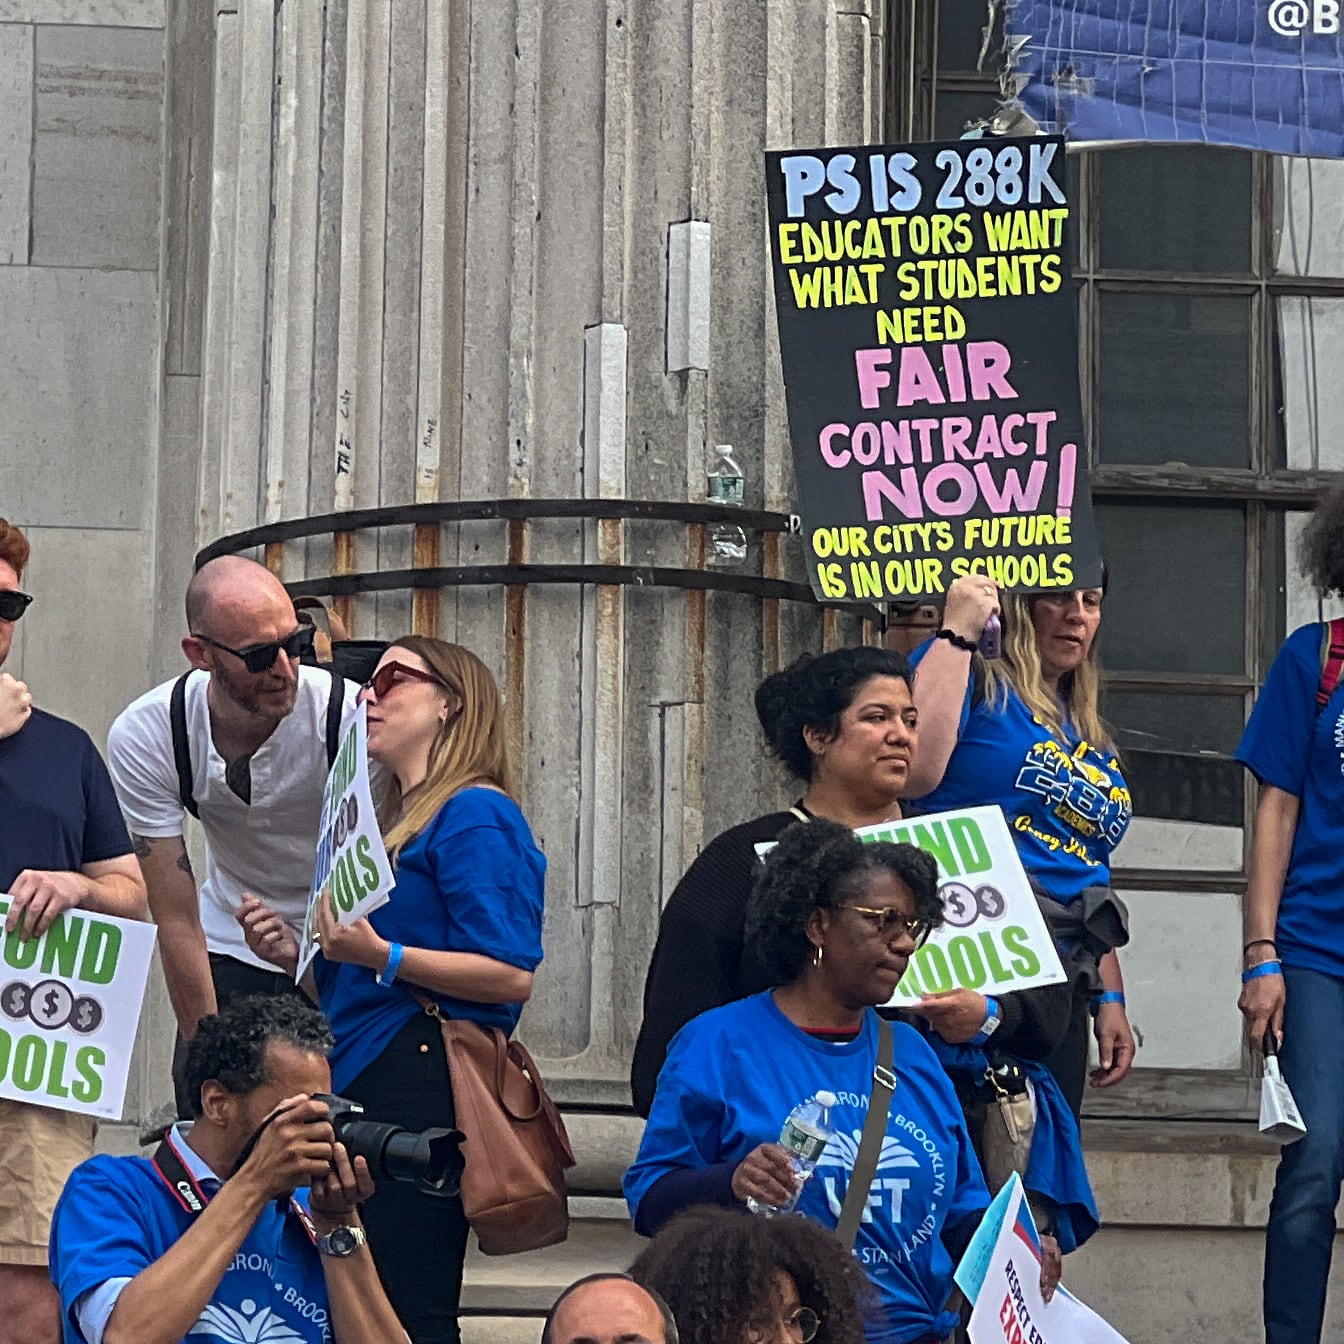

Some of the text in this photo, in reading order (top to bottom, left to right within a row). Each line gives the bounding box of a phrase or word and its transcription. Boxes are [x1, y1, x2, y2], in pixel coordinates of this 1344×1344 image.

[780, 143, 1067, 218] PS IS 288K
[778, 208, 1068, 264] EDUCATORS WANT
[789, 254, 1061, 309] WHAT STUDENTS
[876, 305, 966, 344] NEED
[855, 341, 1019, 409] FAIR
[819, 411, 1057, 468] CONTRACT
[862, 443, 1077, 521] NOW!
[812, 527, 871, 558] OUR
[964, 515, 1072, 550] FUTURE
[817, 563, 846, 598] IS
[850, 561, 883, 598] IN
[885, 558, 944, 595] OUR
[895, 1114, 945, 1197] BROOKLYN
[1004, 1259, 1031, 1329] RESPECT
